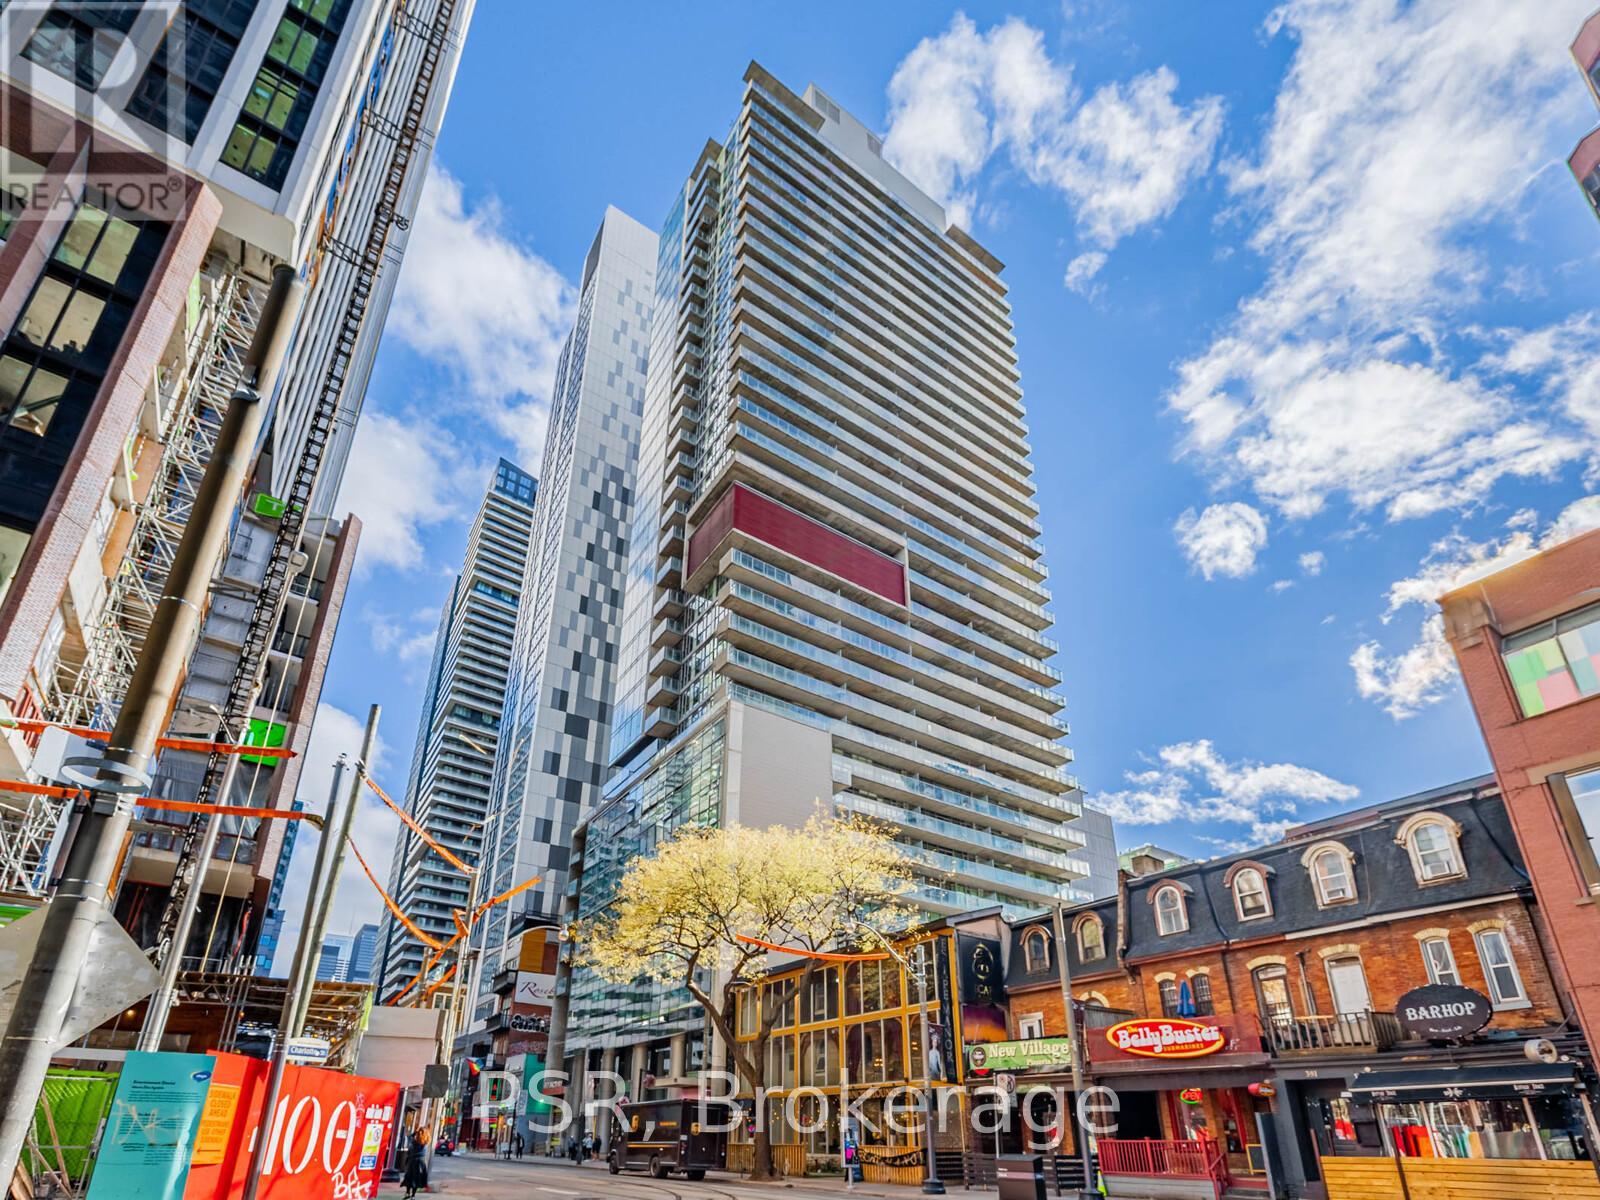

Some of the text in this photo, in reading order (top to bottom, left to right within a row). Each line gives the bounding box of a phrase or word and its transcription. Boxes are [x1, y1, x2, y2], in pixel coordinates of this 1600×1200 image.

[1405, 1001, 1476, 1021] BARHOP
[989, 1040, 1070, 1059] New Village
